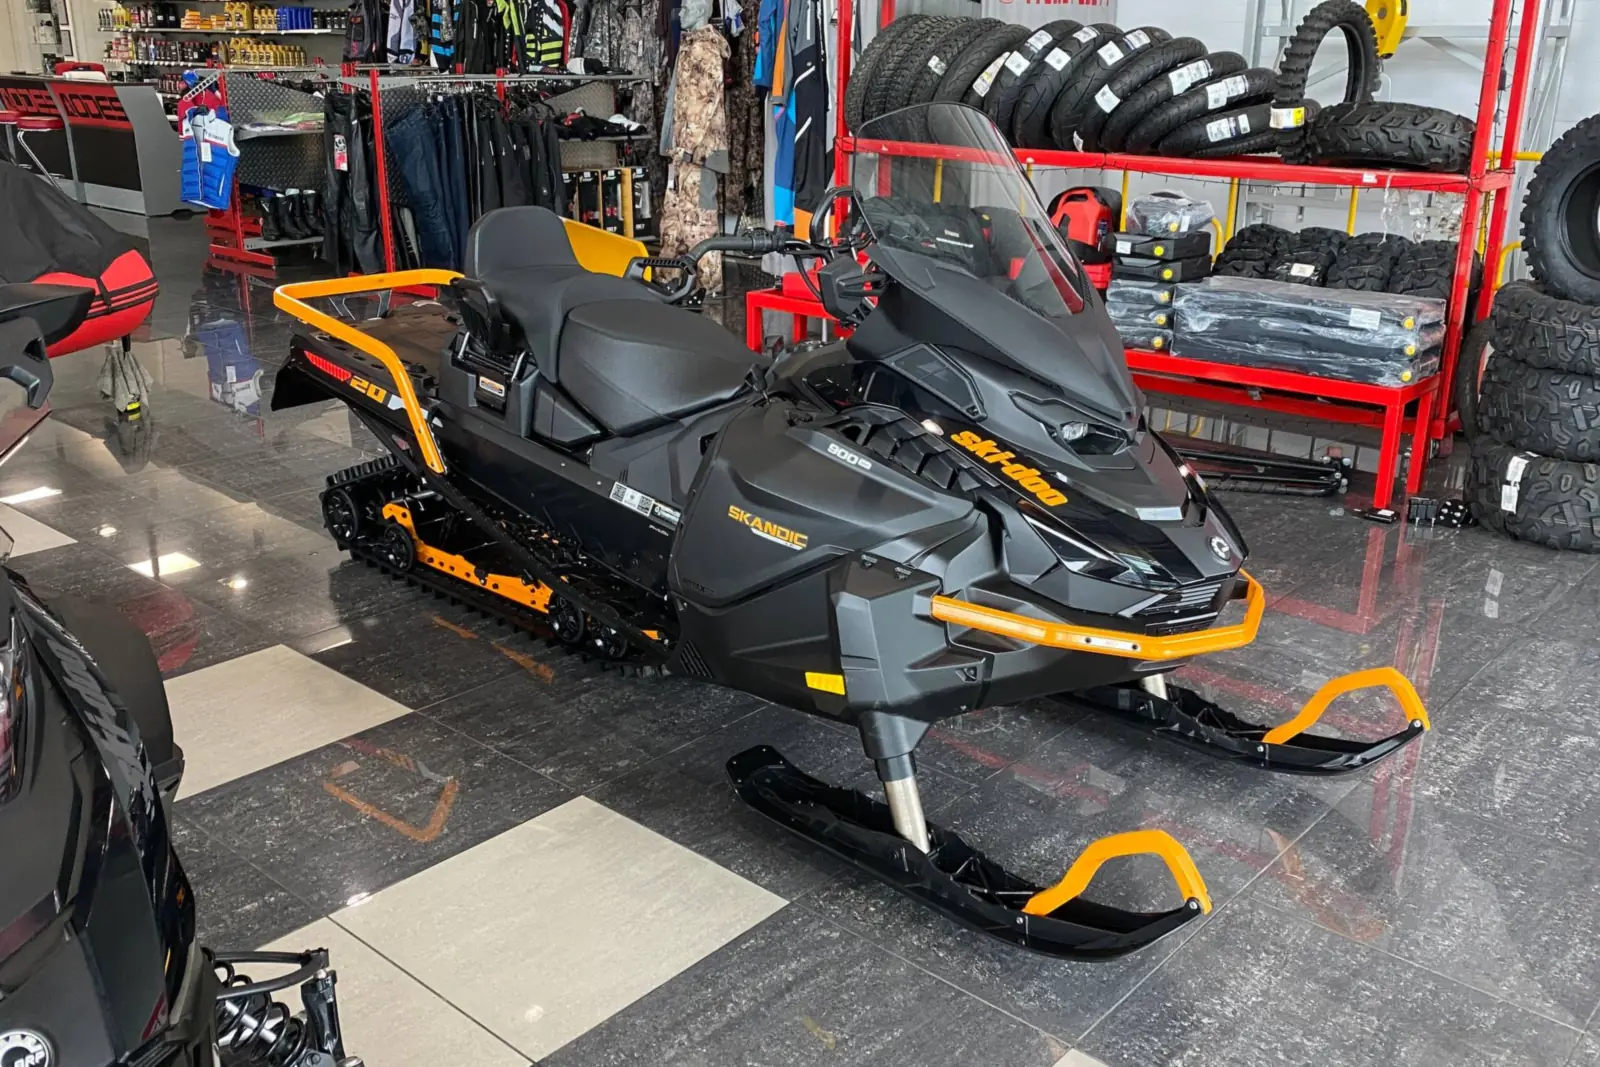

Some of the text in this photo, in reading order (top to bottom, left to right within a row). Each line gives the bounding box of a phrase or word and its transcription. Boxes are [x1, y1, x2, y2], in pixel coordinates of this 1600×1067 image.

[350, 375, 387, 403] 20
[827, 443, 859, 465] 900
[950, 430, 1068, 507] ski-doo
[727, 504, 808, 549] SKANDIC
